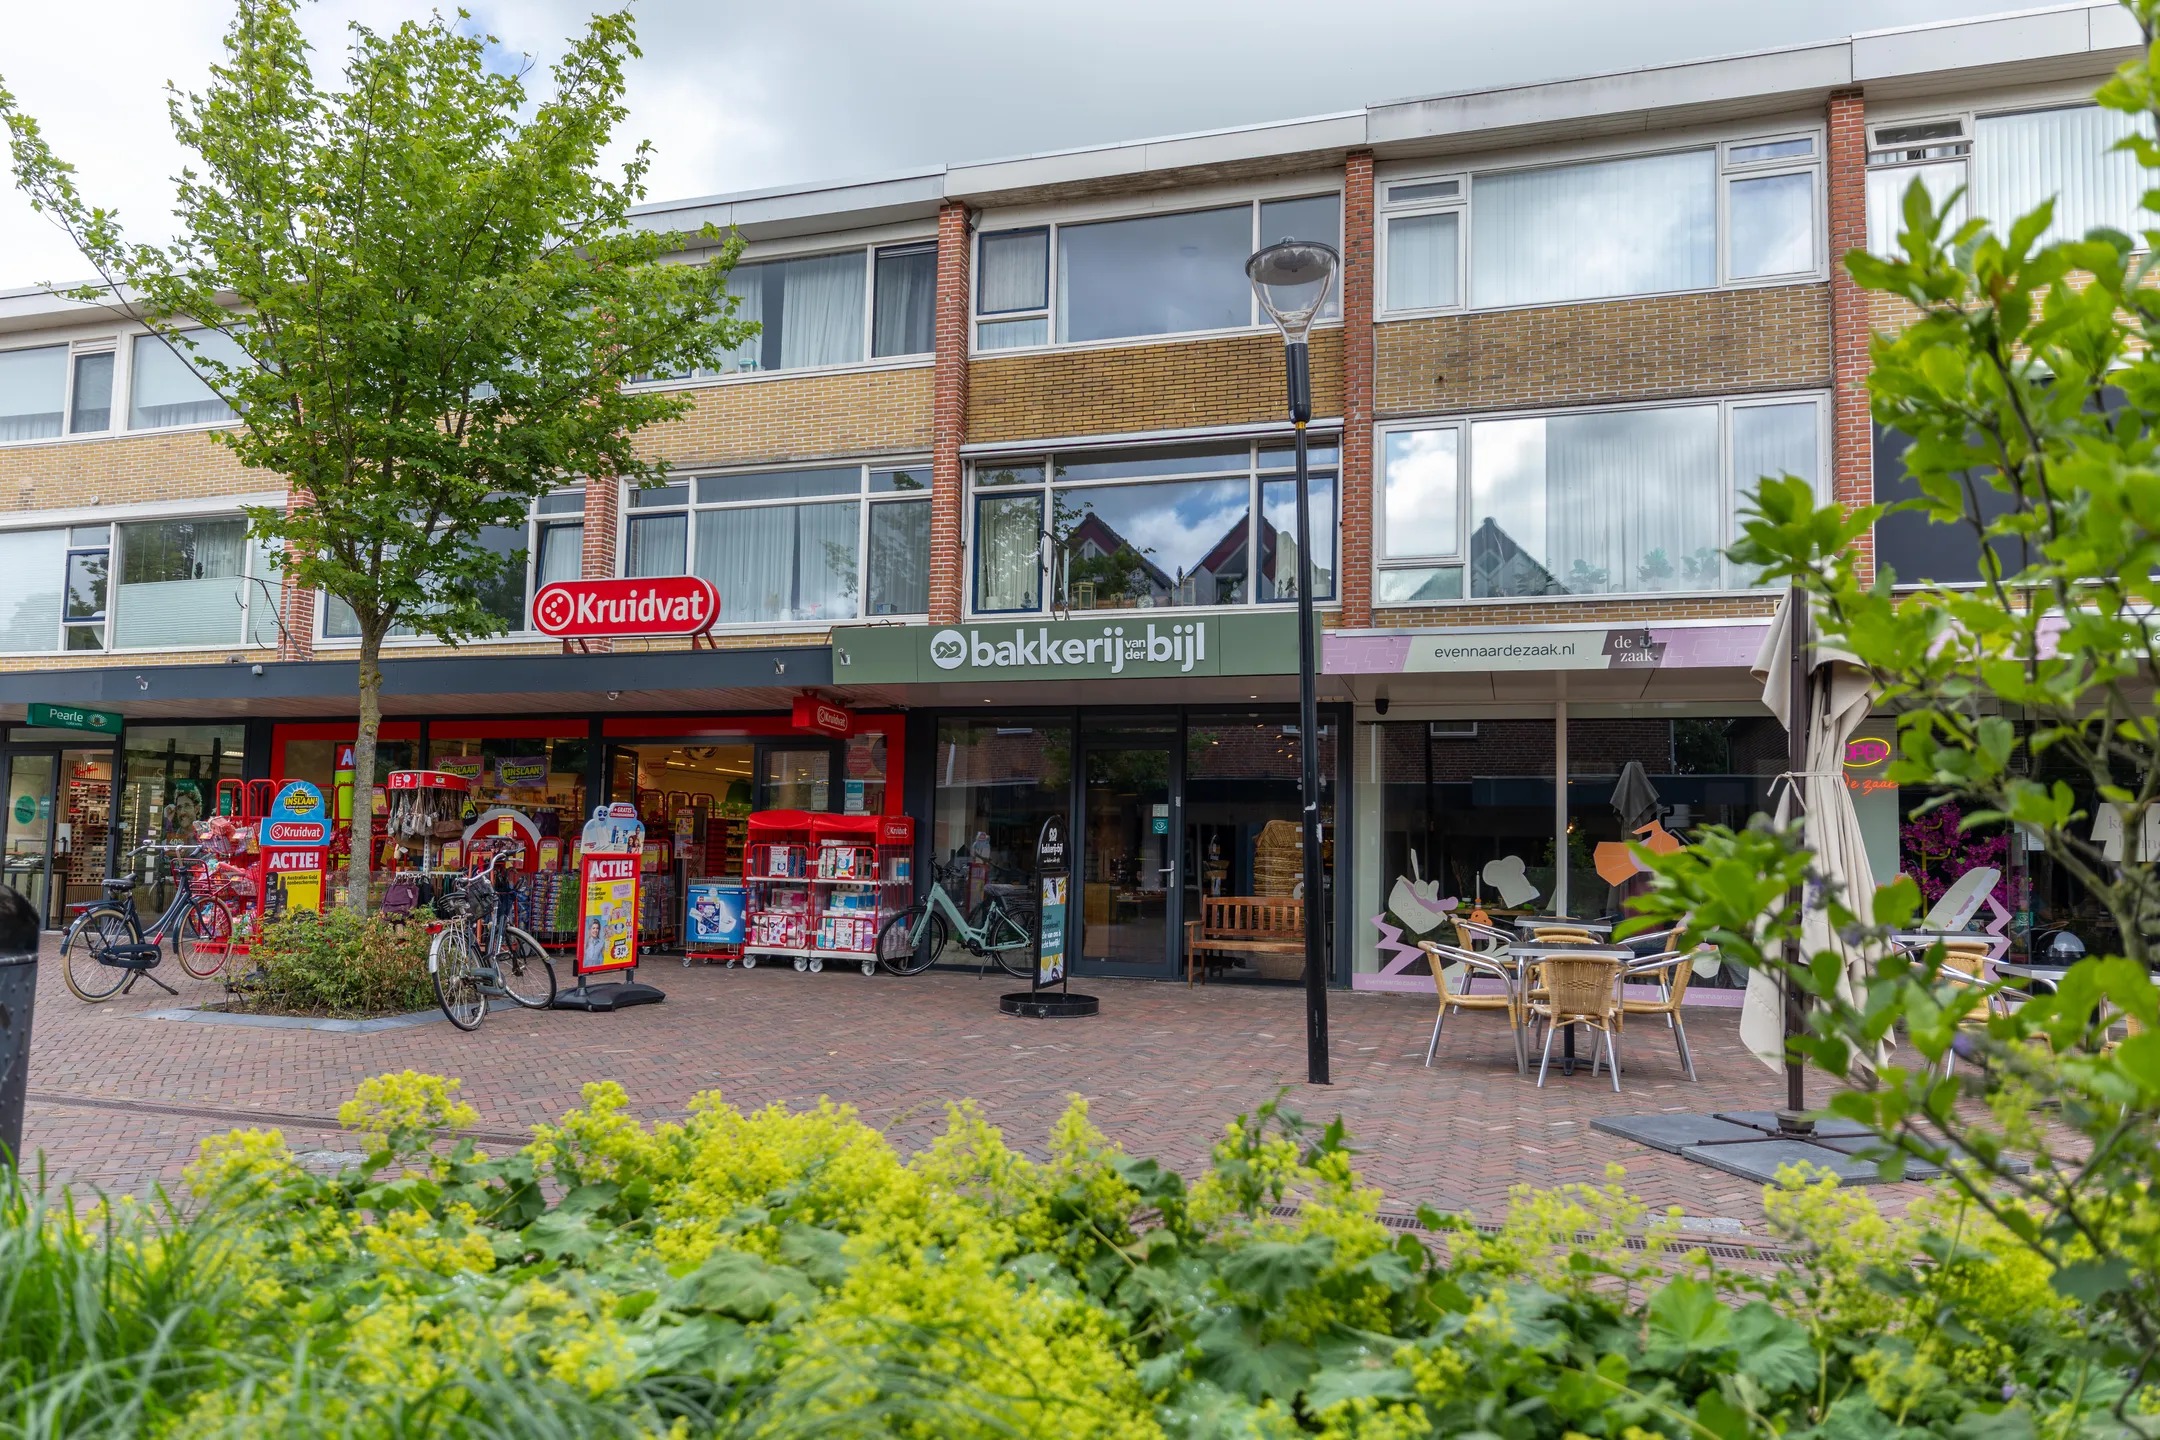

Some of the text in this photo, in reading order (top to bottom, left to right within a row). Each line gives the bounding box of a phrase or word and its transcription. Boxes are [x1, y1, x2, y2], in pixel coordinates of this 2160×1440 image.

[577, 588, 704, 624] Kruidvat
[971, 622, 1205, 674] bakkerij bijl
[1125, 639, 1146, 649] van
[1614, 636, 1632, 649] de
[1125, 649, 1146, 661] der
[1434, 643, 1575, 658] evennaardezaak.nl
[1620, 649, 1653, 662] zaak
[49, 708, 83, 723] Pearle
[825, 711, 846, 728] Kruidvat
[1844, 743, 1887, 761] OPEN
[285, 796, 319, 806] INSLAAN!
[284, 826, 321, 837] Kruidvat
[269, 851, 320, 869] ACTIE!
[589, 860, 633, 878] ACTIE!
